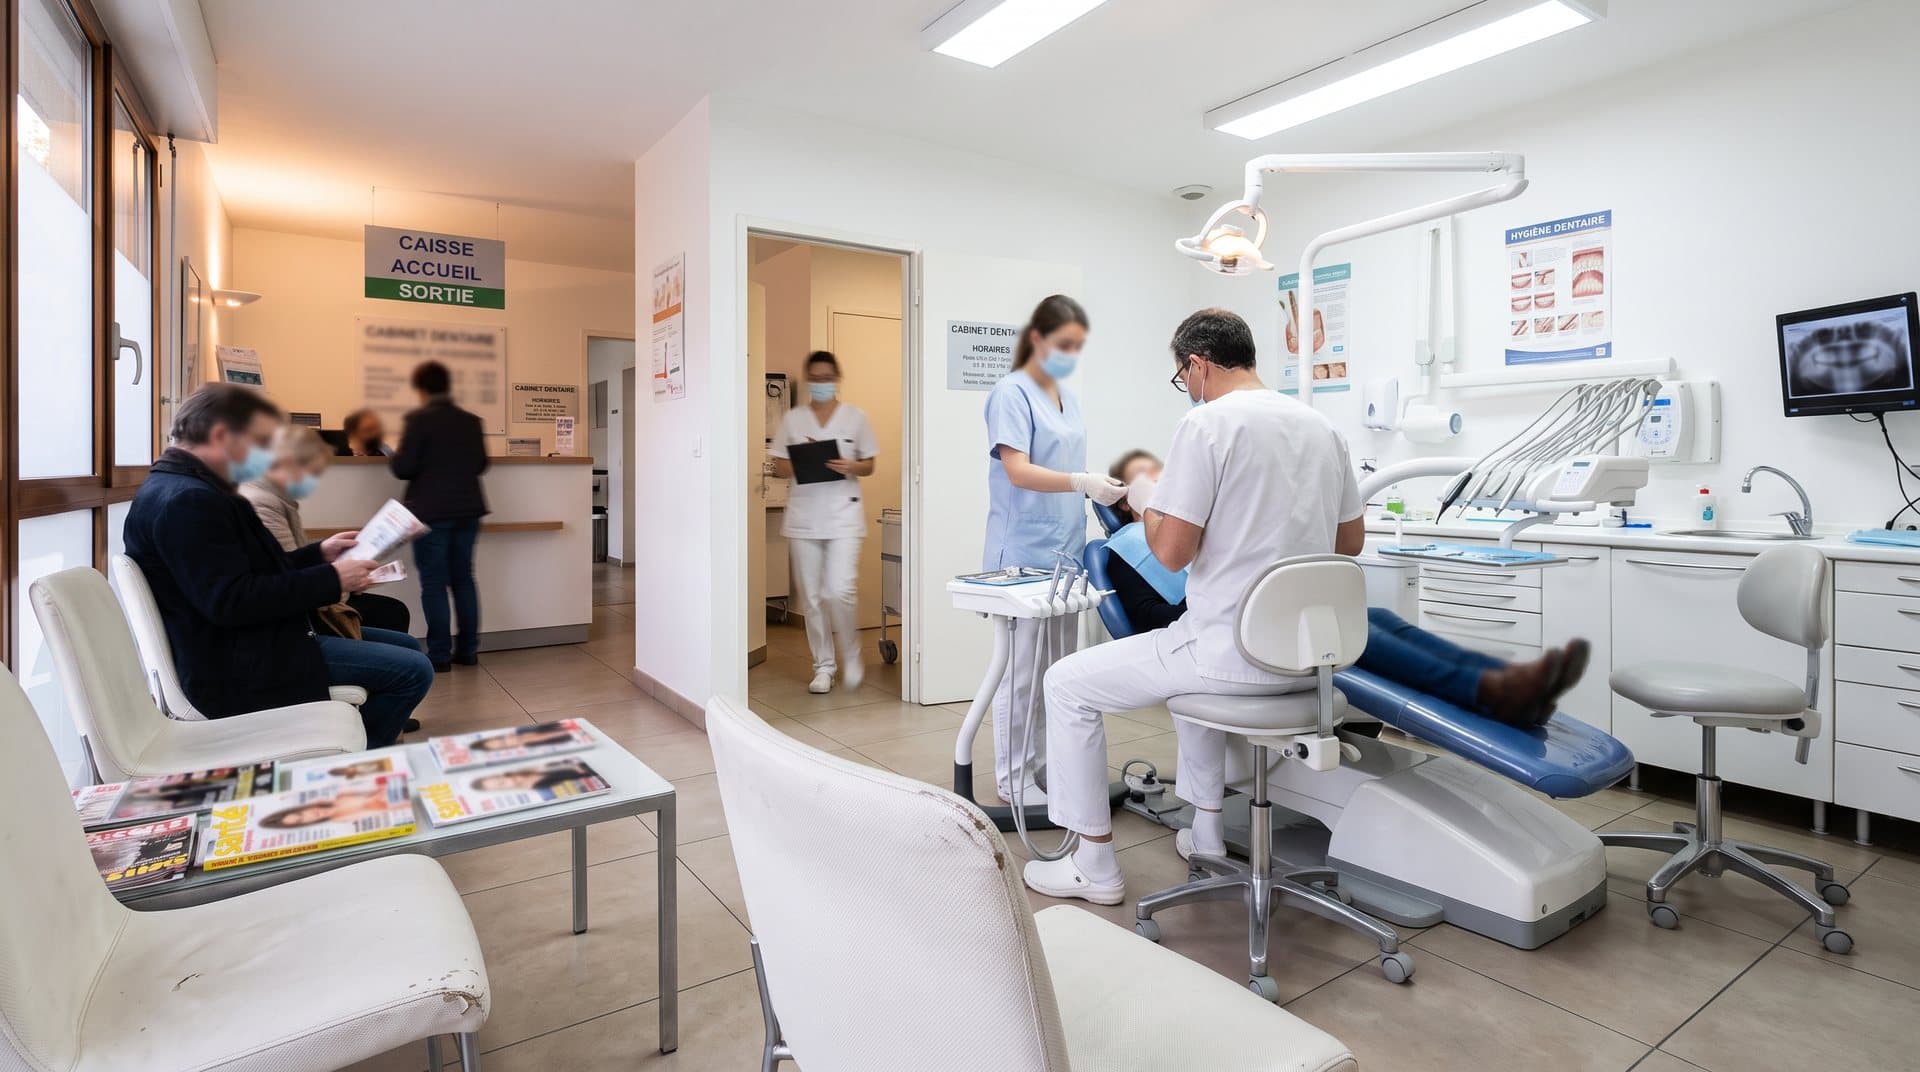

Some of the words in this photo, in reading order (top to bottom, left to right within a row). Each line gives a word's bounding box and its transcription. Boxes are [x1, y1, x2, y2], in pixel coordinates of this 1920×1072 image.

[1554, 215, 1605, 233] DENTAIRE
[399, 235, 474, 257] CAISSE
[391, 259, 482, 281] ACCUEIL
[399, 283, 474, 304] SORTIE
[951, 325, 988, 335] CABINET
[990, 328, 1017, 336] DENTA
[972, 344, 1011, 354] HORAIRES
